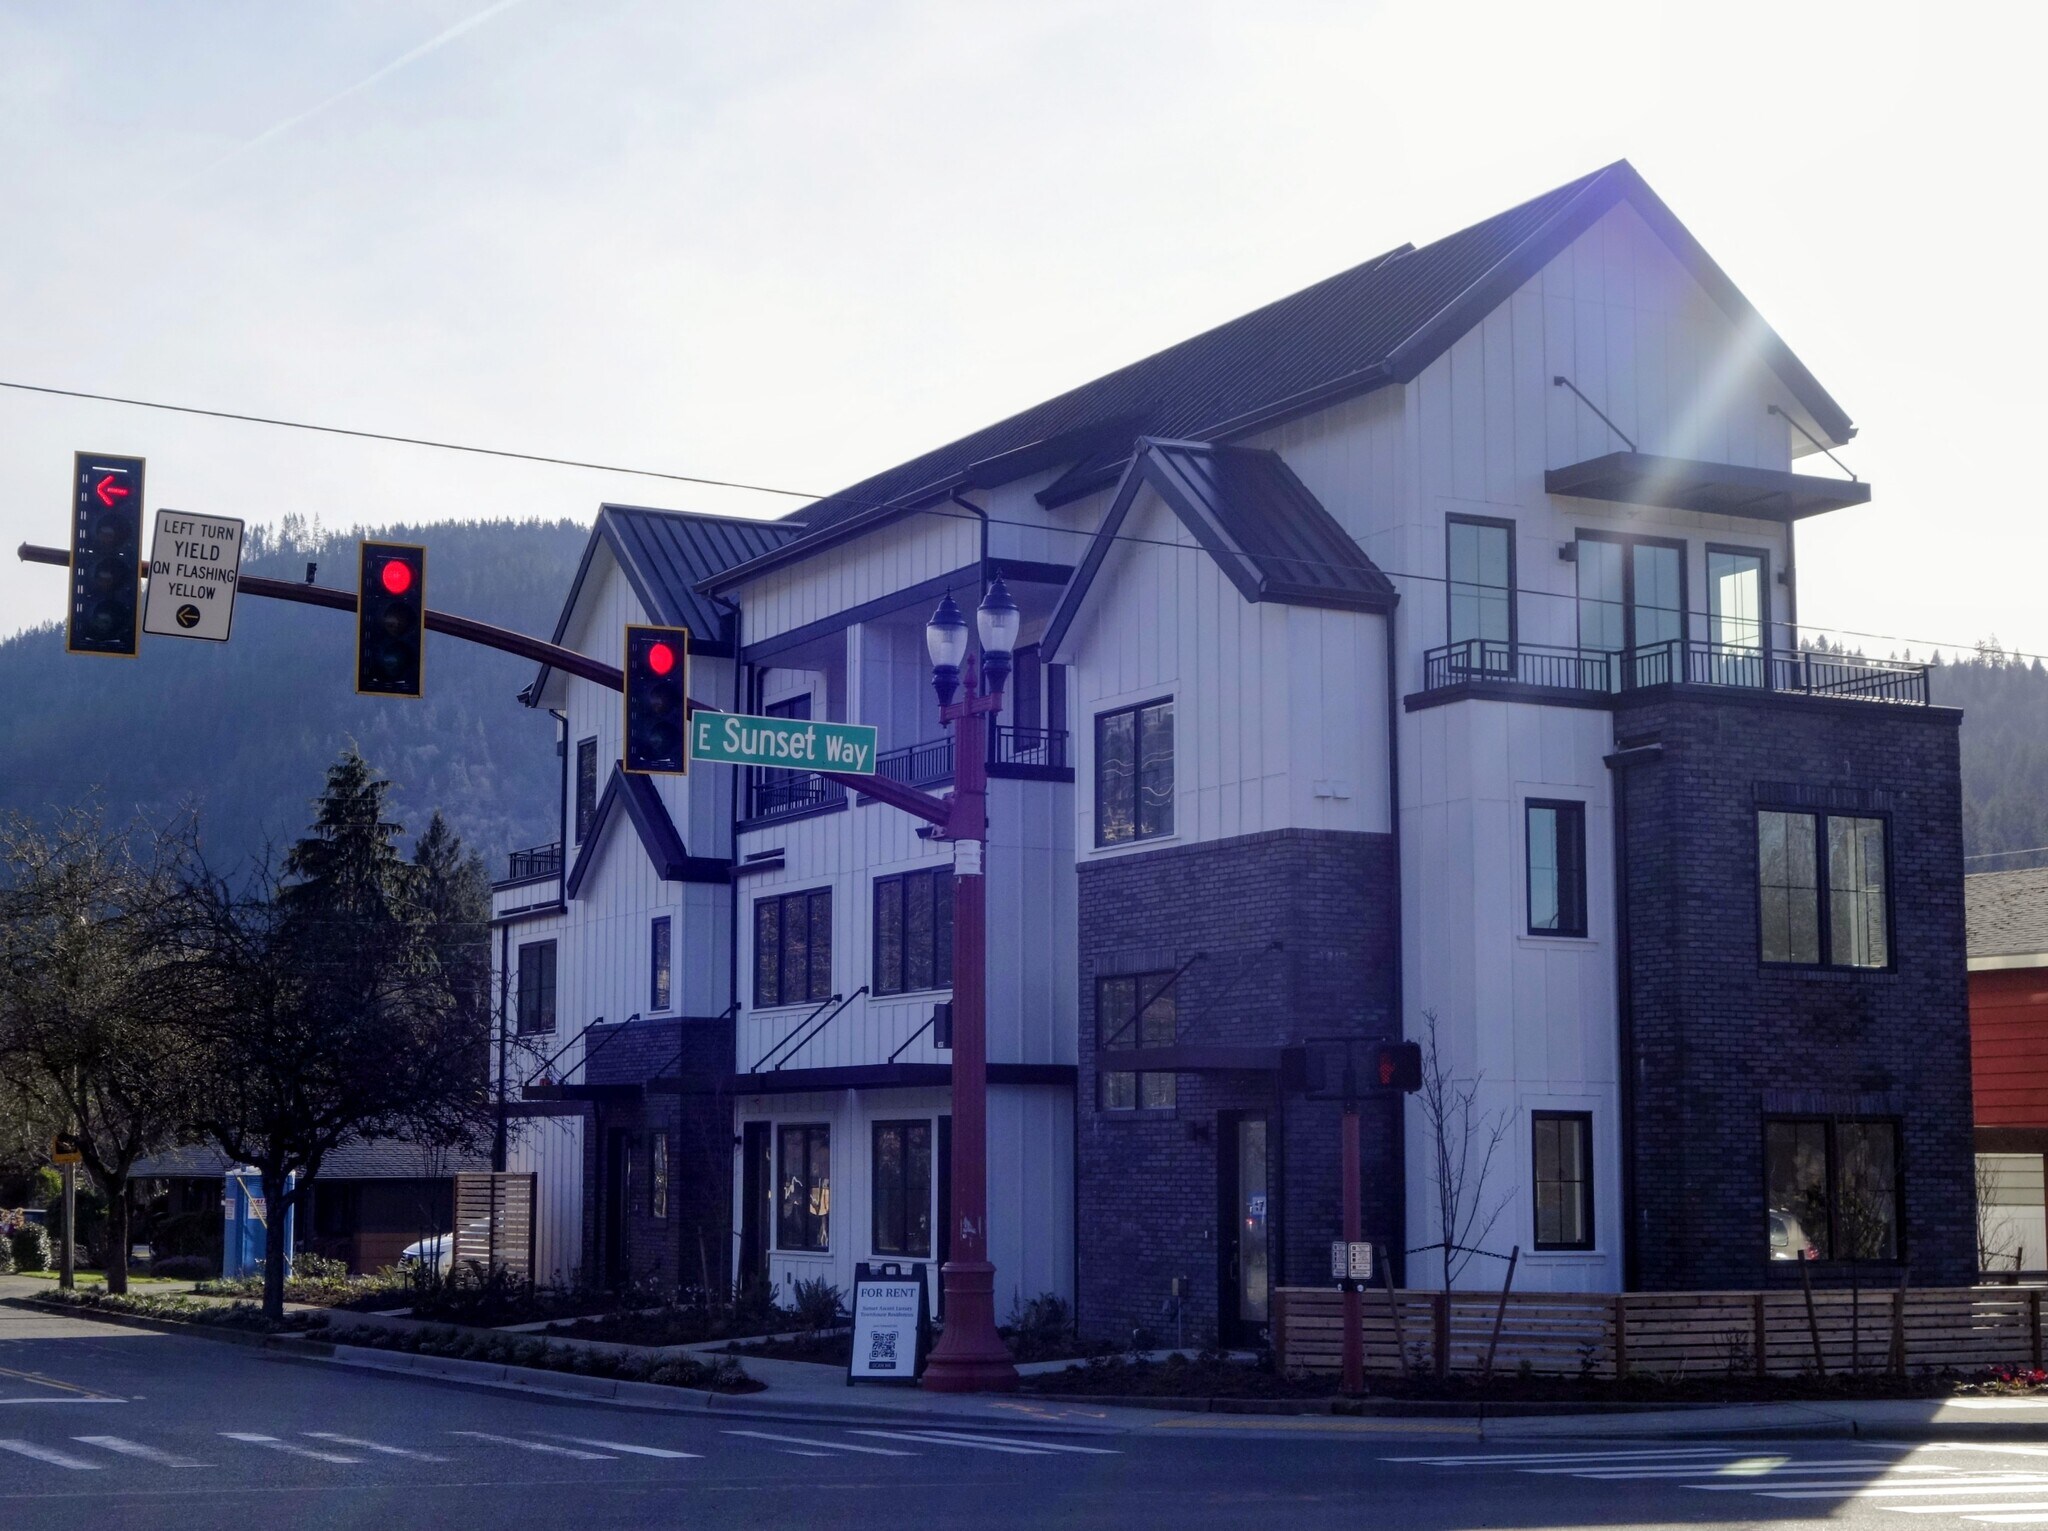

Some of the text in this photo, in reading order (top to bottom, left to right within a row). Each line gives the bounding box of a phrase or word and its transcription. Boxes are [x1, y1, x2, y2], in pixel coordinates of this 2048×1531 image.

[164, 519, 234, 541] LEFT TURN
[175, 540, 220, 561] YIELD
[153, 560, 235, 583] ON FLASHING
[168, 582, 216, 600] YELLOW
[698, 717, 868, 771] E Sunset Way
[861, 1288, 916, 1298] FOR RENT
